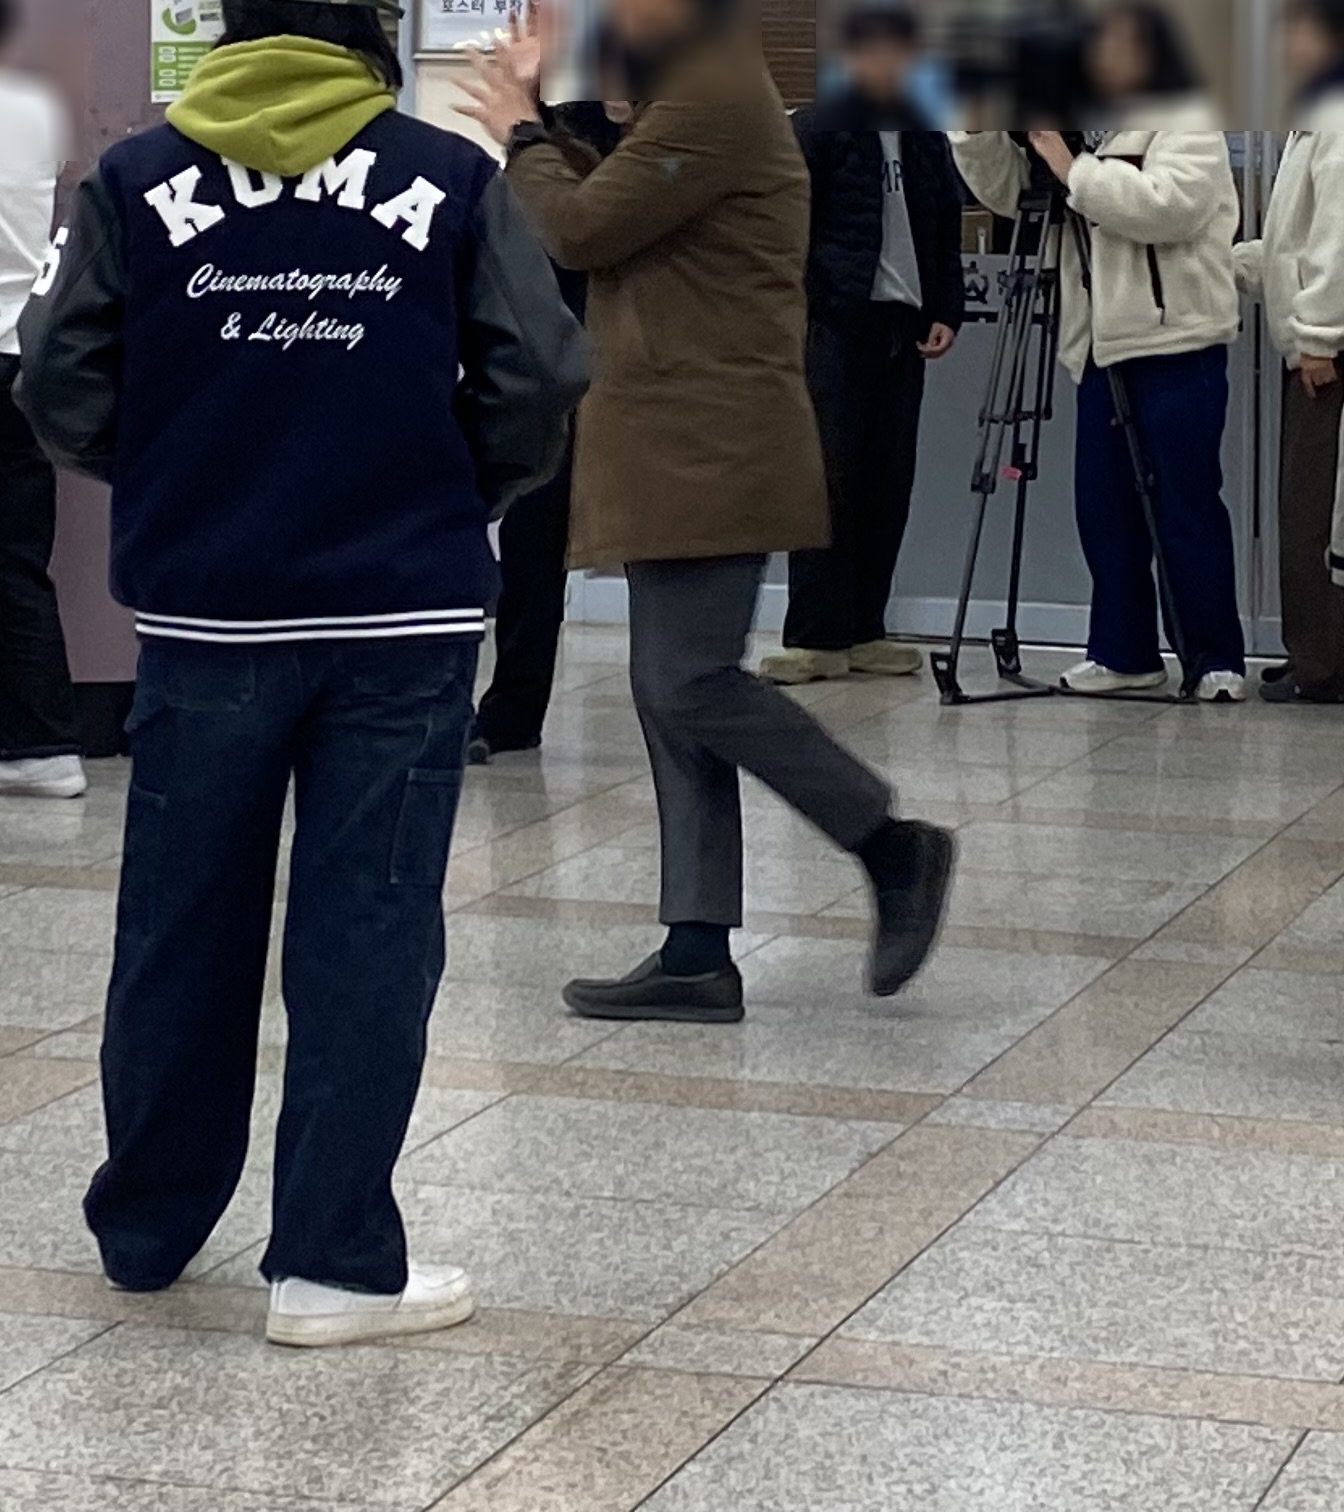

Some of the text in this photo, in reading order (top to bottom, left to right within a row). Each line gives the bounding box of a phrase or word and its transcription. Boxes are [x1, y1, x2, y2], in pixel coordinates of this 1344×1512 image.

[441, 0, 485, 15] 포스터
[186, 262, 403, 301] Cinematography
[220, 310, 366, 351] & Lighting
